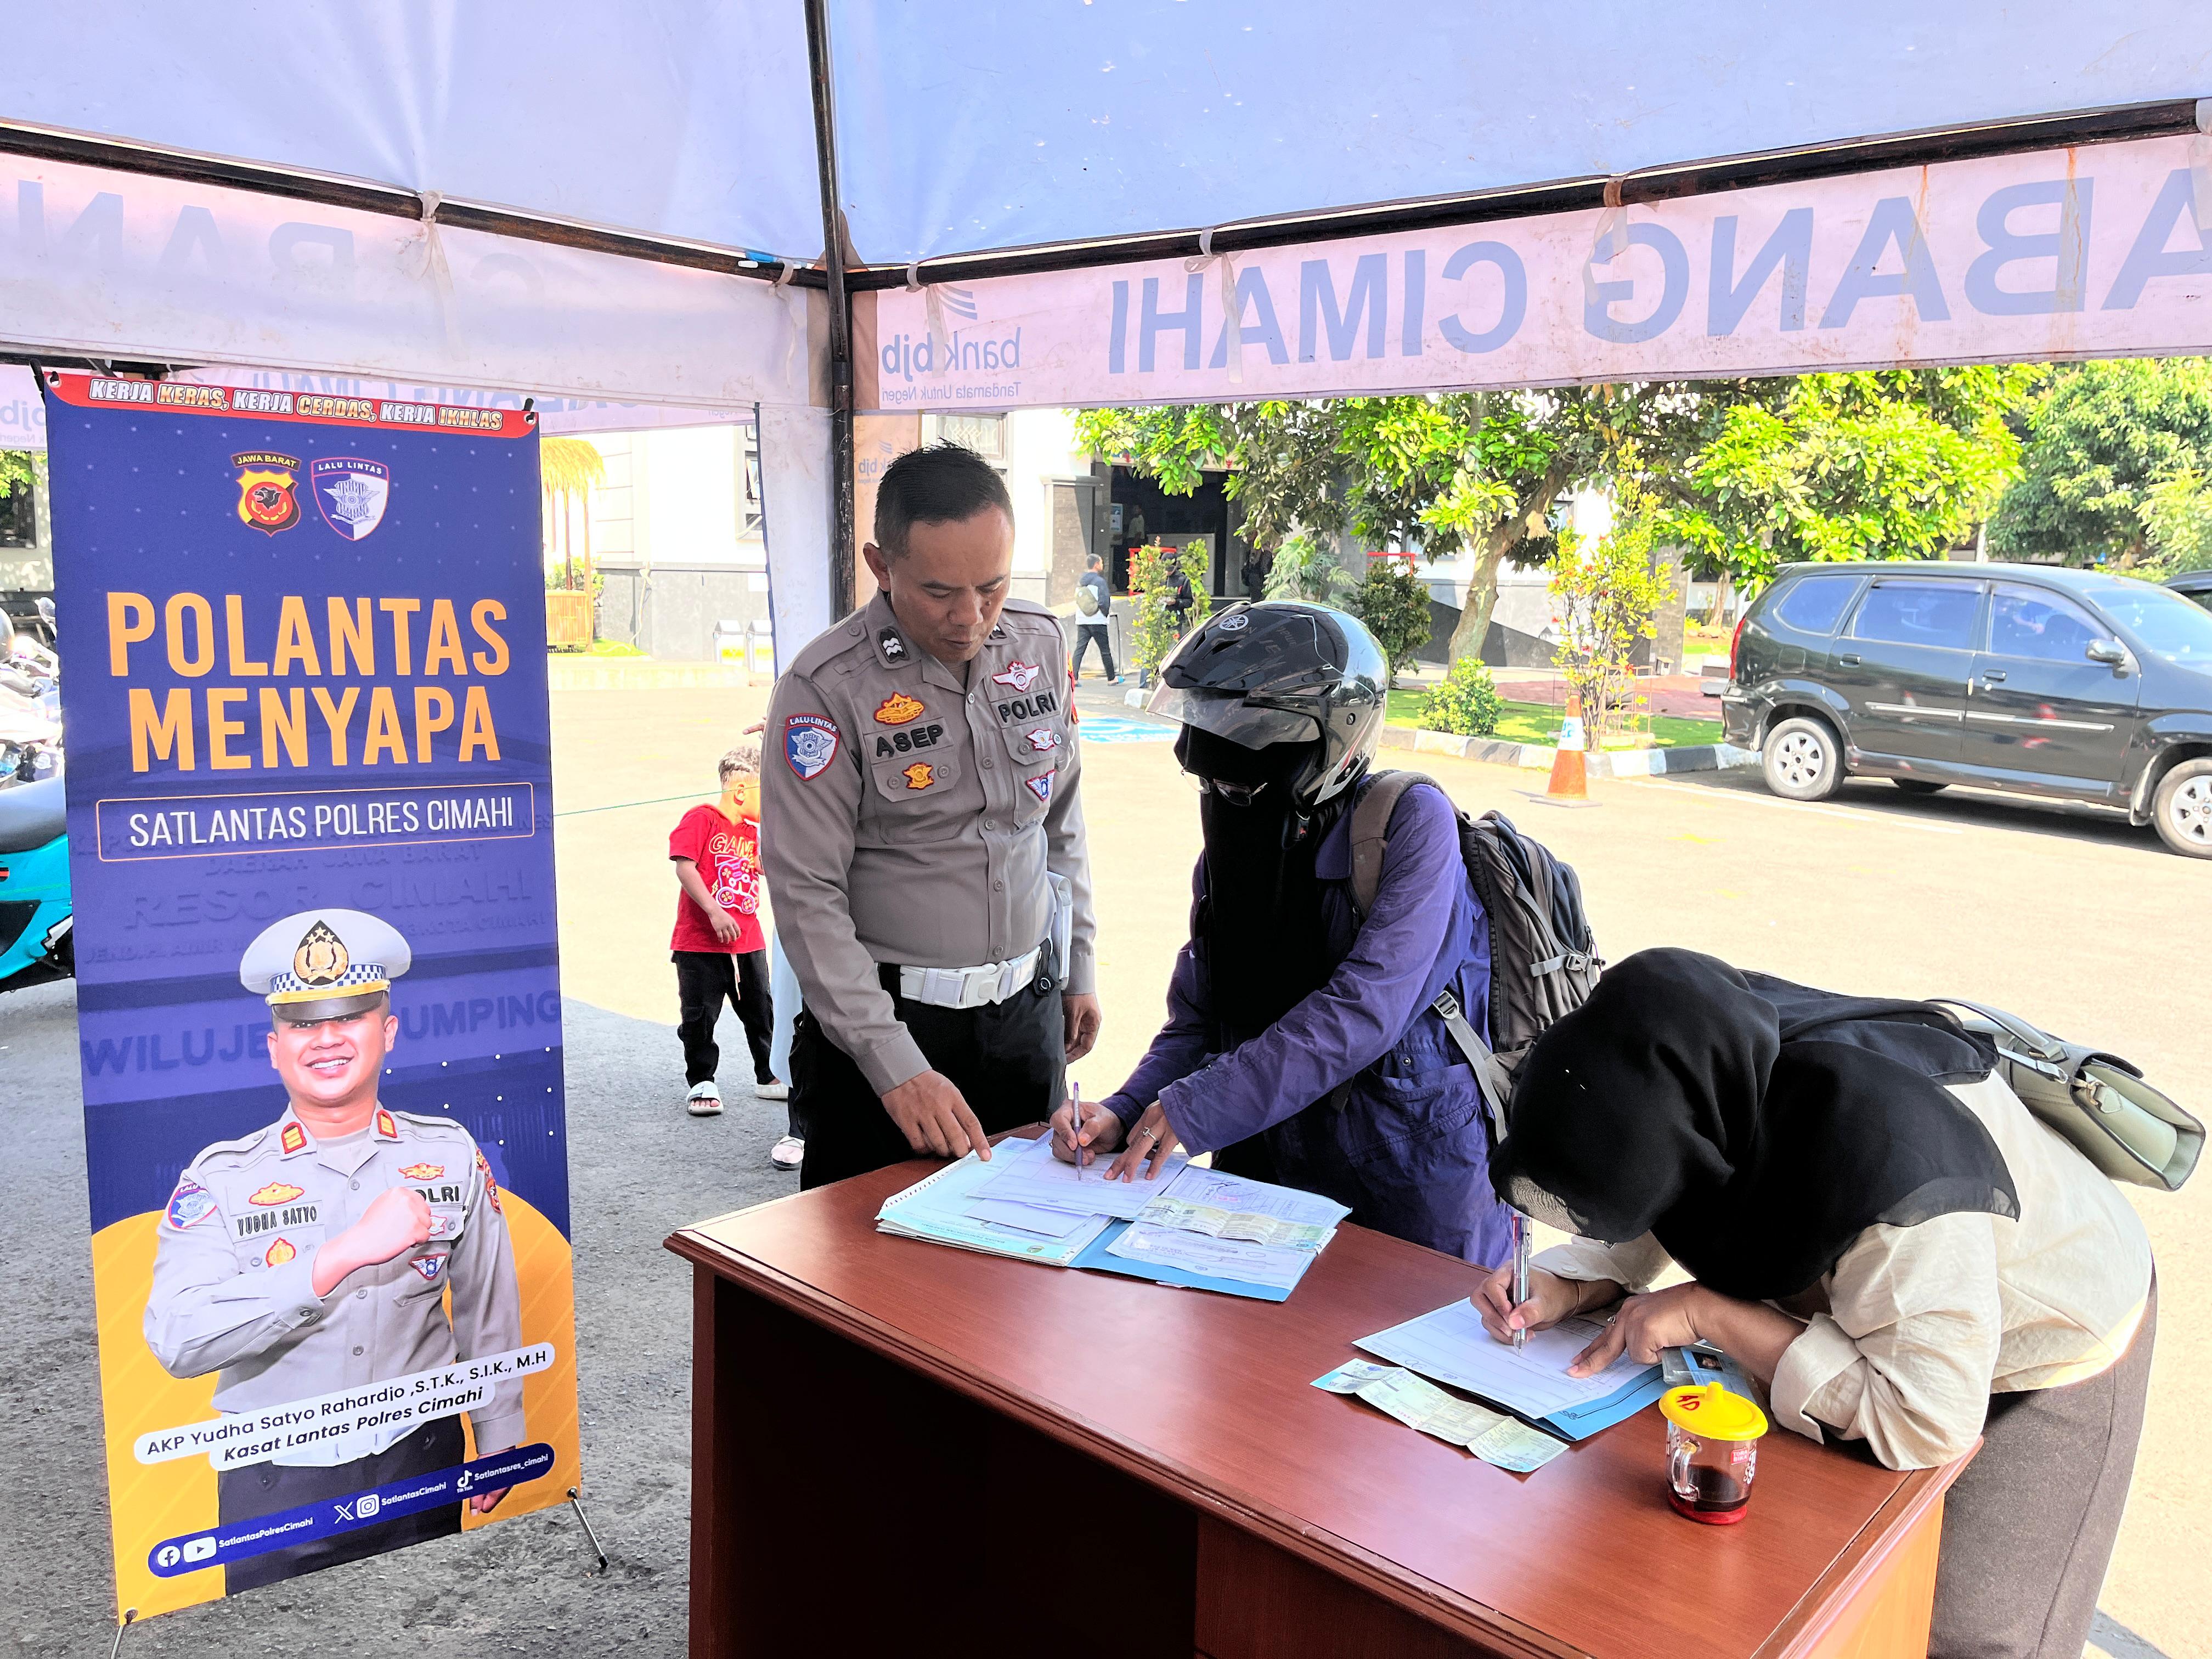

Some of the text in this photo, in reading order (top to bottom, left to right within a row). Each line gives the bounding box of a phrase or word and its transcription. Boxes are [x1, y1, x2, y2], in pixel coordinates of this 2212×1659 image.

[90, 379, 503, 430] KERJA KERAS, KERJA CERDAS, KERJA IKHLAS
[237, 454, 297, 468] JAWA BARAT
[318, 461, 382, 475] LALU LINTAS
[107, 592, 510, 678] POLANTAS
[789, 716, 837, 732] LALU LINTAS
[998, 691, 1057, 723] POLRI
[128, 686, 501, 772] MENYAPA
[877, 724, 944, 758] ASEP
[129, 808, 307, 848] SATLANTAS
[315, 802, 420, 837] POLRES
[427, 797, 514, 831] CIMAHI
[122, 883, 320, 928] RESOR
[81, 1022, 269, 1076] WILUJE
[237, 1205, 317, 1237] YUDHA SATYO
[147, 1436, 185, 1455] AKP
[190, 1423, 254, 1445] Yudha
[260, 1408, 315, 1430] Satyo
[321, 1386, 405, 1417] Rahardio
[470, 1362, 512, 1380] S.I.K.,
[517, 1350, 547, 1369] M.H
[223, 1386, 483, 1462] Kasat Lantas Polres Cimahi
[474, 1453, 549, 1481] Satlantasres_cimahi
[381, 1481, 447, 1507] SatlantasCimahi
[218, 1516, 314, 1548] SatlantasPolresCimahi
